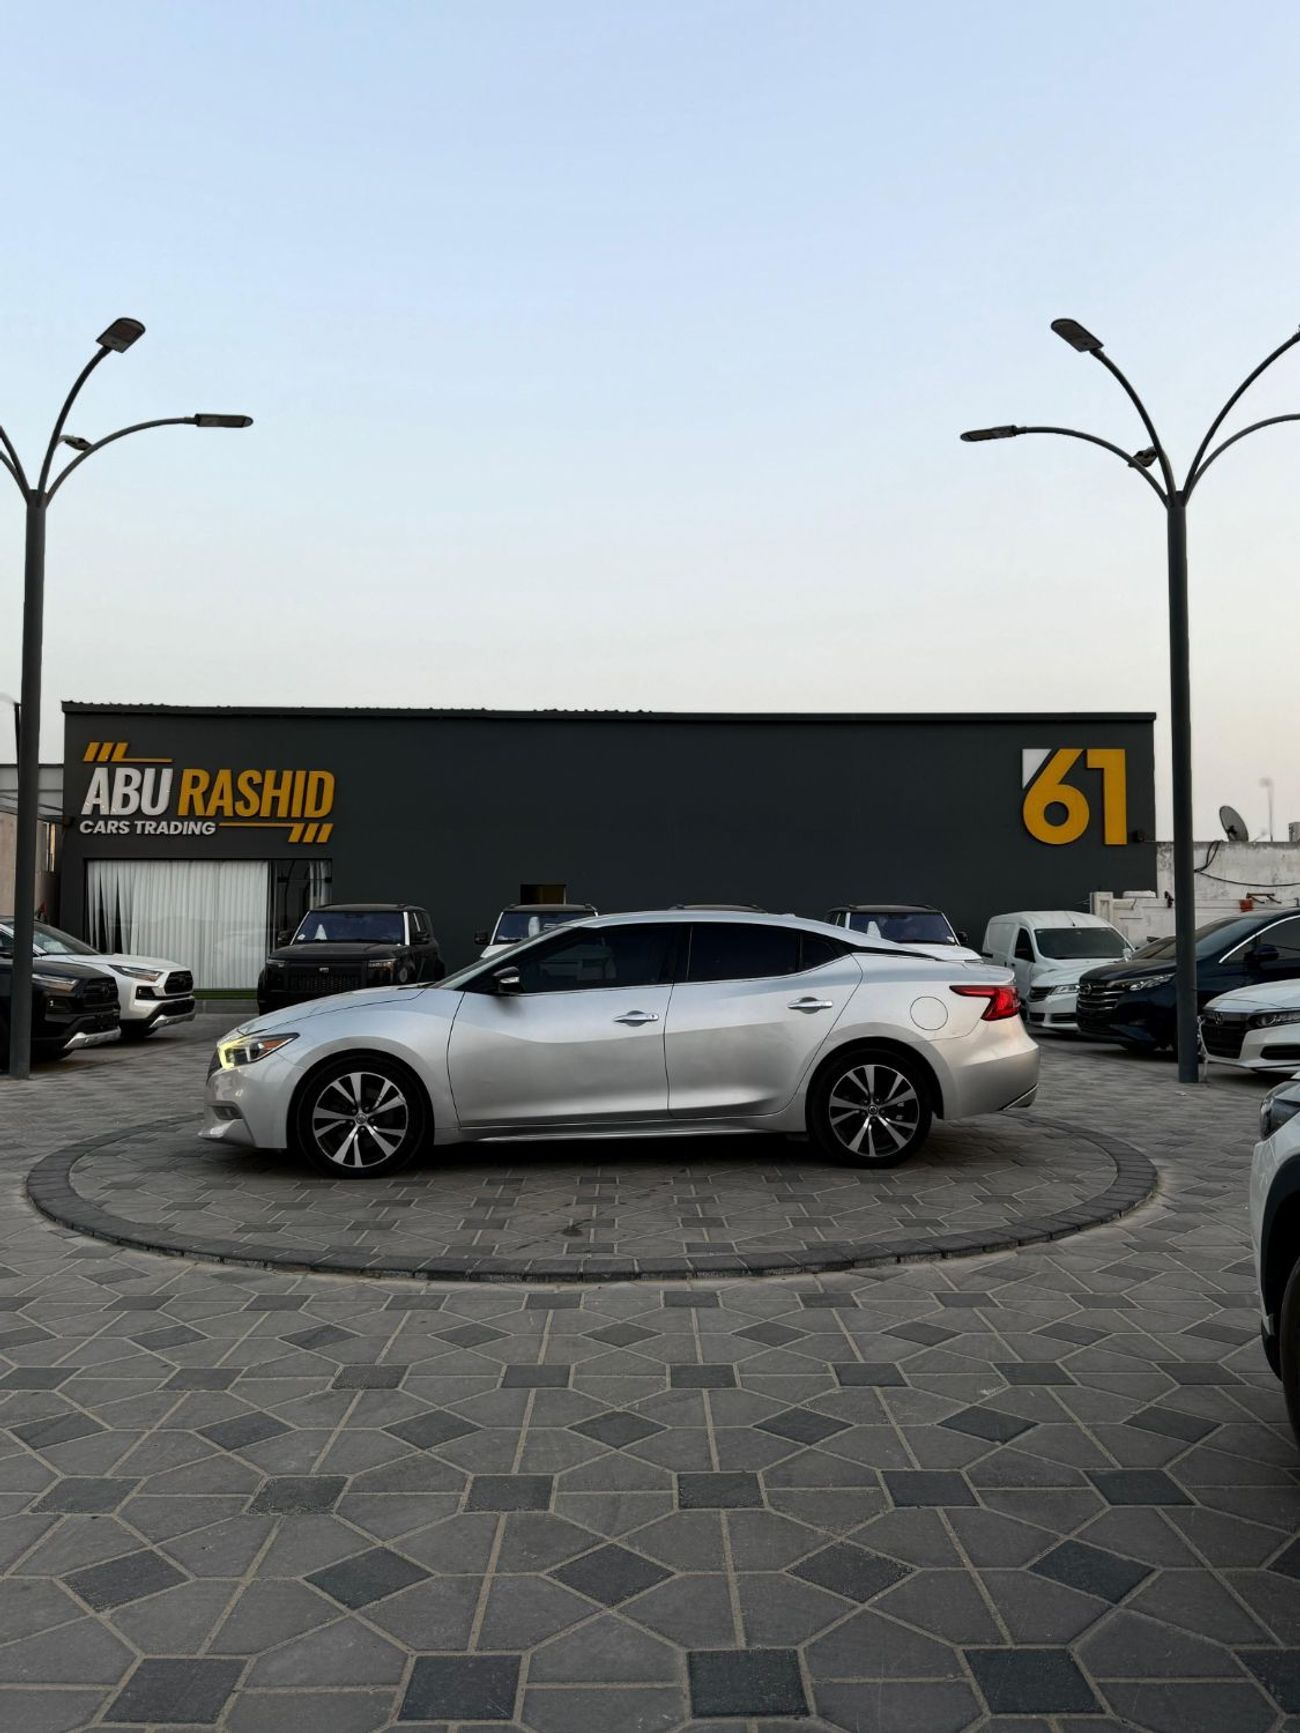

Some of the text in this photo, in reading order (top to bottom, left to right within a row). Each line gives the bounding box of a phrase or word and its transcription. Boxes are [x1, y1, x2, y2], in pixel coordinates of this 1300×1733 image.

[80, 767, 336, 818] ABU RASHID
[1022, 748, 1128, 845] 61
[79, 820, 216, 836] CARS TRADING
